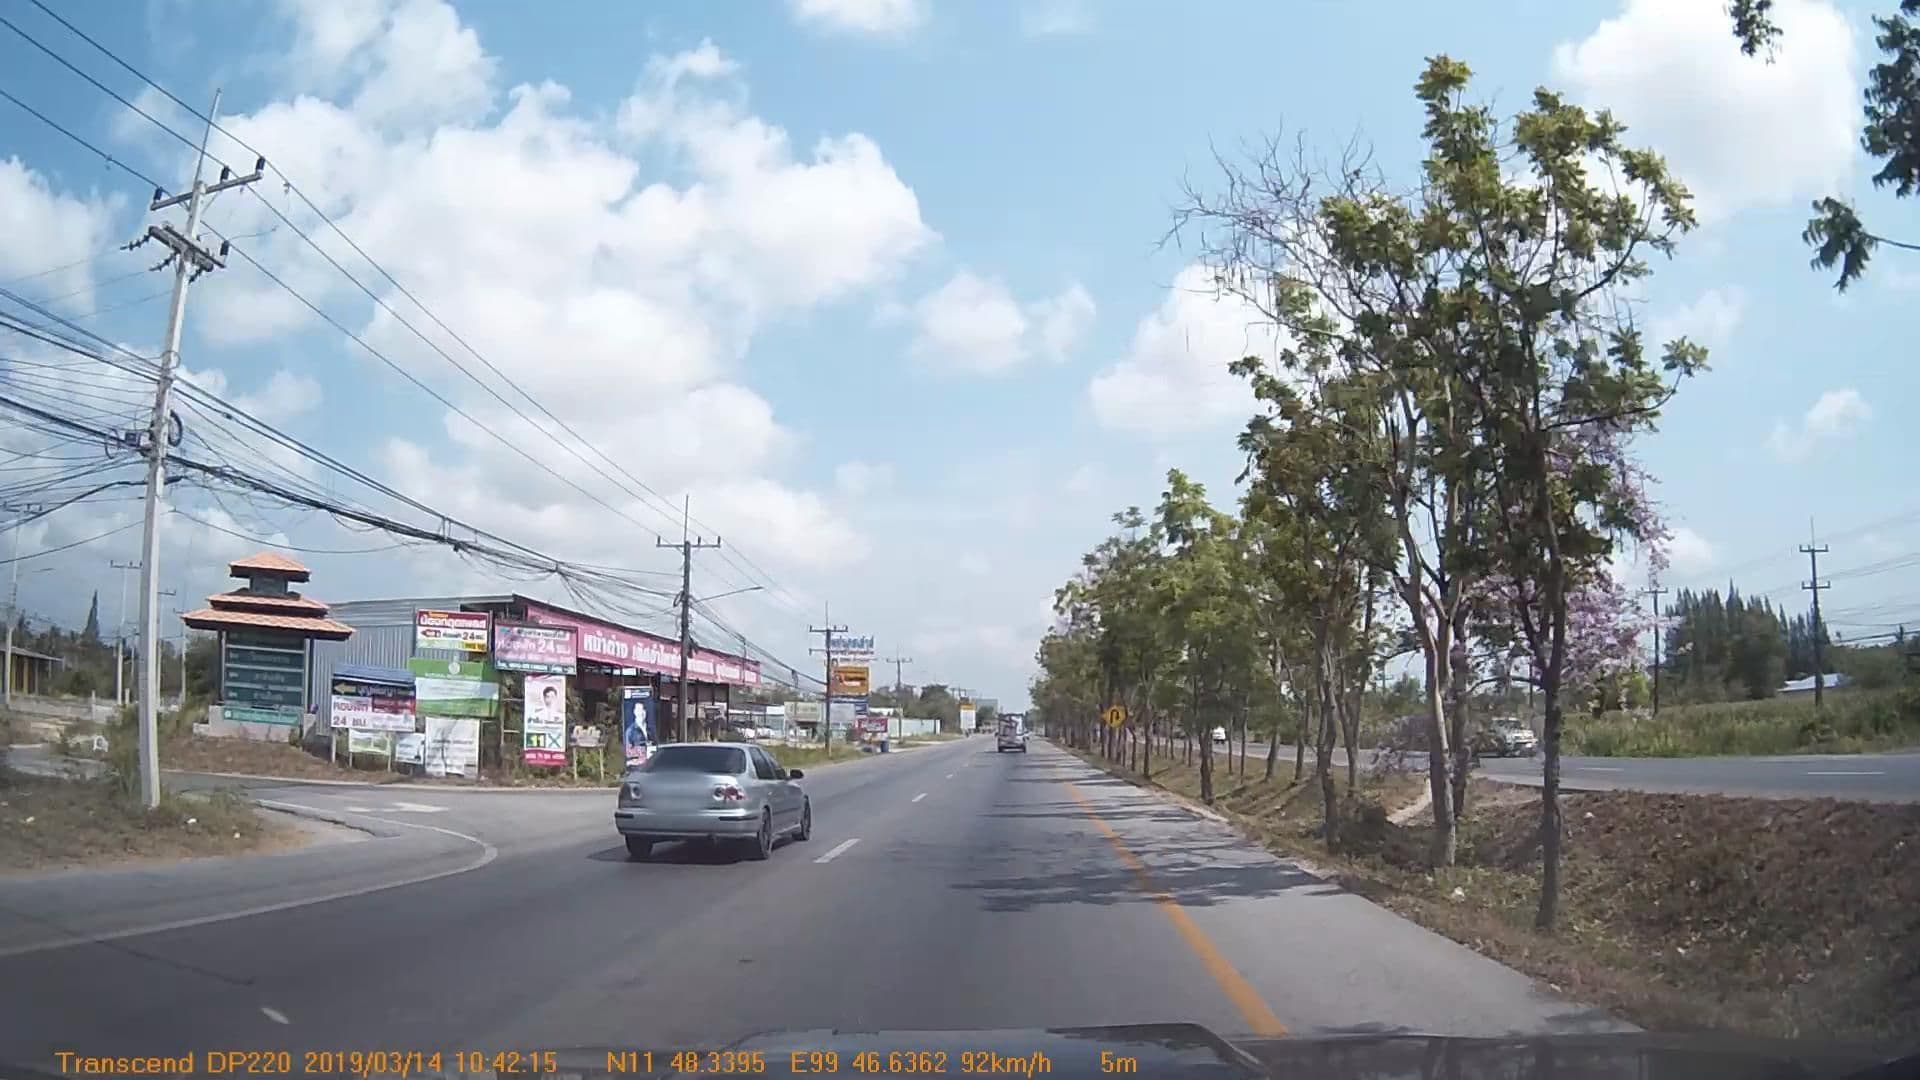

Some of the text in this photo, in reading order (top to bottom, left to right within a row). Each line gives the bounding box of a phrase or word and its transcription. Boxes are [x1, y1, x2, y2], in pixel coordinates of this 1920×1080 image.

[462, 631, 475, 641] 24
[538, 639, 555, 653] 24
[584, 630, 628, 659] หน้าต่าง
[333, 715, 347, 726] 24
